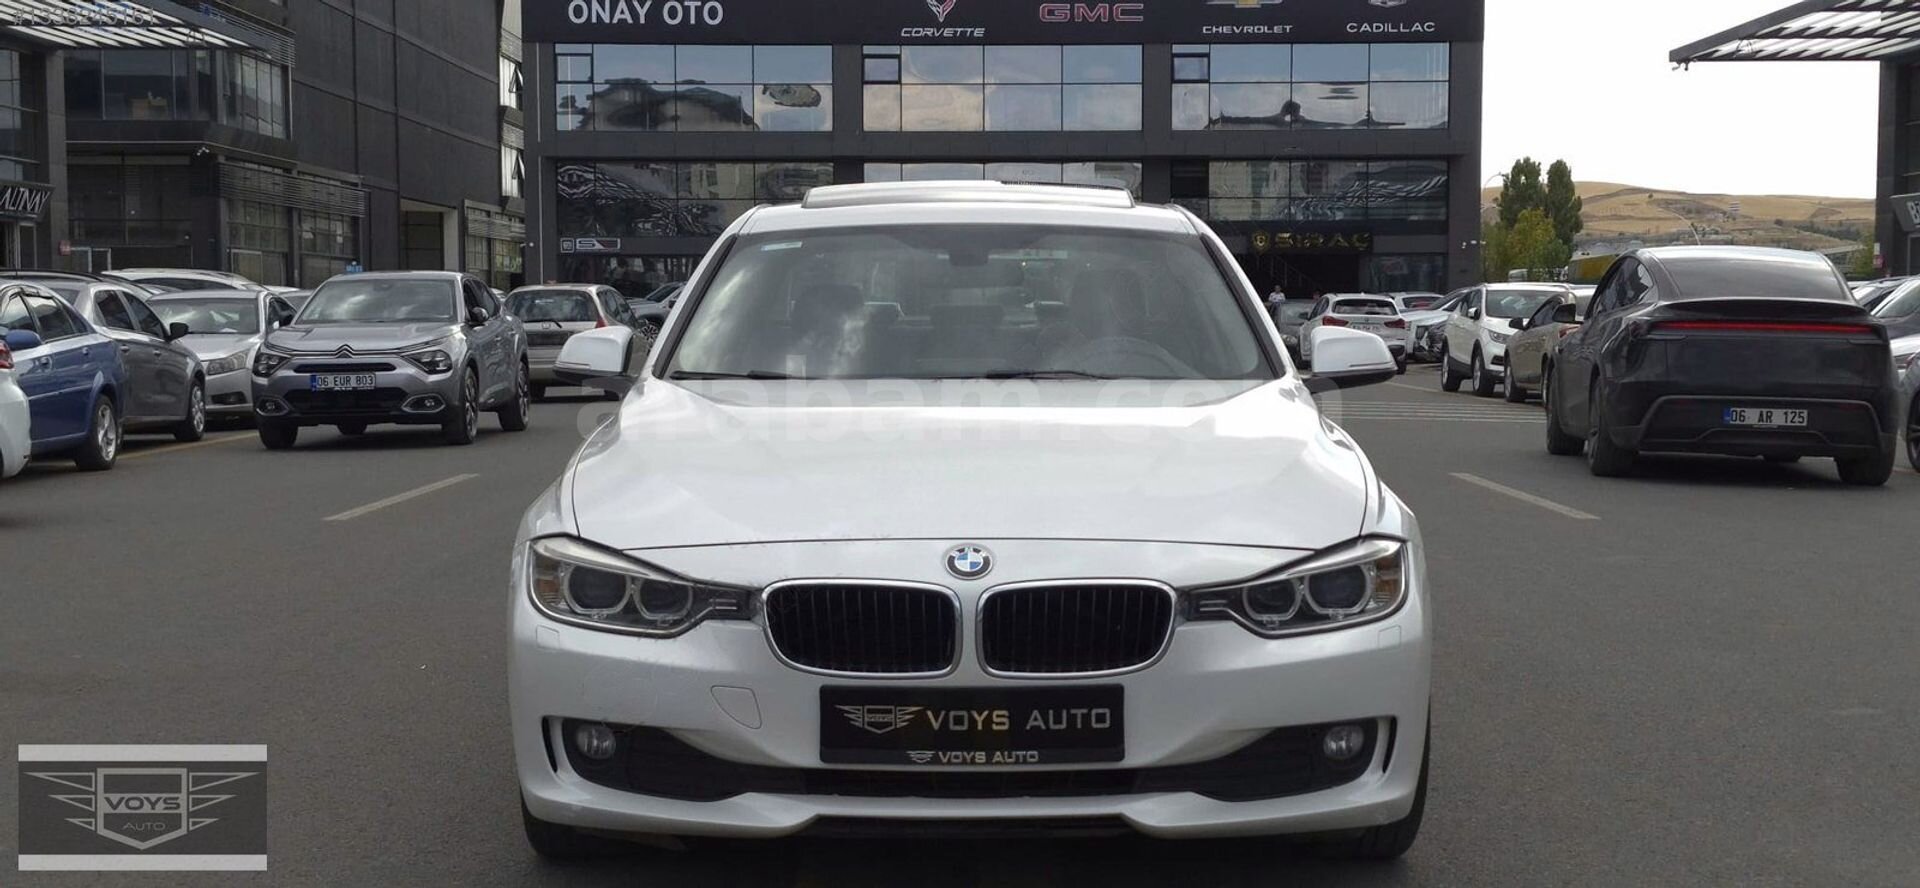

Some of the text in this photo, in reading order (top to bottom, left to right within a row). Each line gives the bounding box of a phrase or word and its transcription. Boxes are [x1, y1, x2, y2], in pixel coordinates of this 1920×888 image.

[567, 0, 724, 25] ONAY OTO
[1039, 3, 1144, 22] GMC
[900, 27, 987, 37] CORVETTE
[1202, 25, 1294, 34] CHEVROLET
[1346, 22, 1436, 33] CADILLAC
[316, 375, 374, 387] 06 EUR 803
[1731, 409, 1805, 424] 06 AR 125
[926, 708, 1111, 731] VOYS AUTO
[938, 751, 1040, 763] VOYS AUTO
